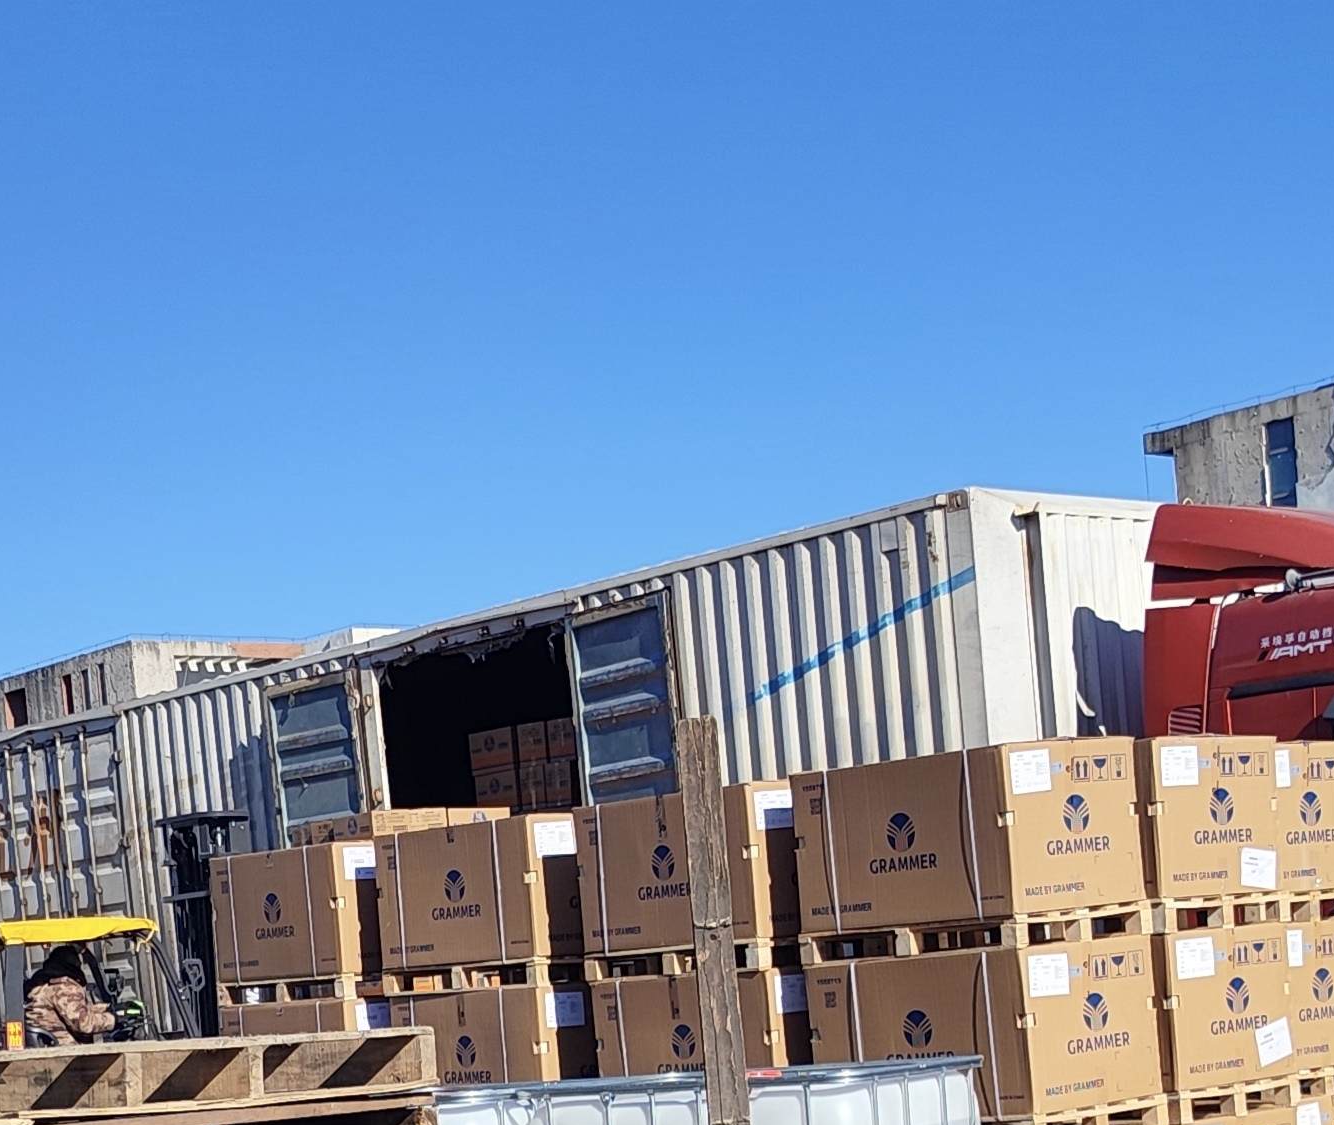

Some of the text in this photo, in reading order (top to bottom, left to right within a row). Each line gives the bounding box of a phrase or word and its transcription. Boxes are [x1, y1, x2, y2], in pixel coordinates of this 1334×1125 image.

[1194, 828, 1253, 845] GRAMMER
[1047, 836, 1110, 856] GRAMMER
[870, 853, 938, 875] GRAMMER
[1173, 873, 1189, 882] MADE
[1025, 885, 1043, 896] MADE
[431, 904, 481, 922] GRAMMER
[255, 925, 295, 940] GRAMMER
[1211, 1015, 1268, 1035] GRAMMER
[1067, 1032, 1130, 1055] GRAMMER
[444, 1070, 491, 1084] GRAMMER
[1189, 1065, 1206, 1074] MADE
[1046, 1086, 1063, 1097] MADE
